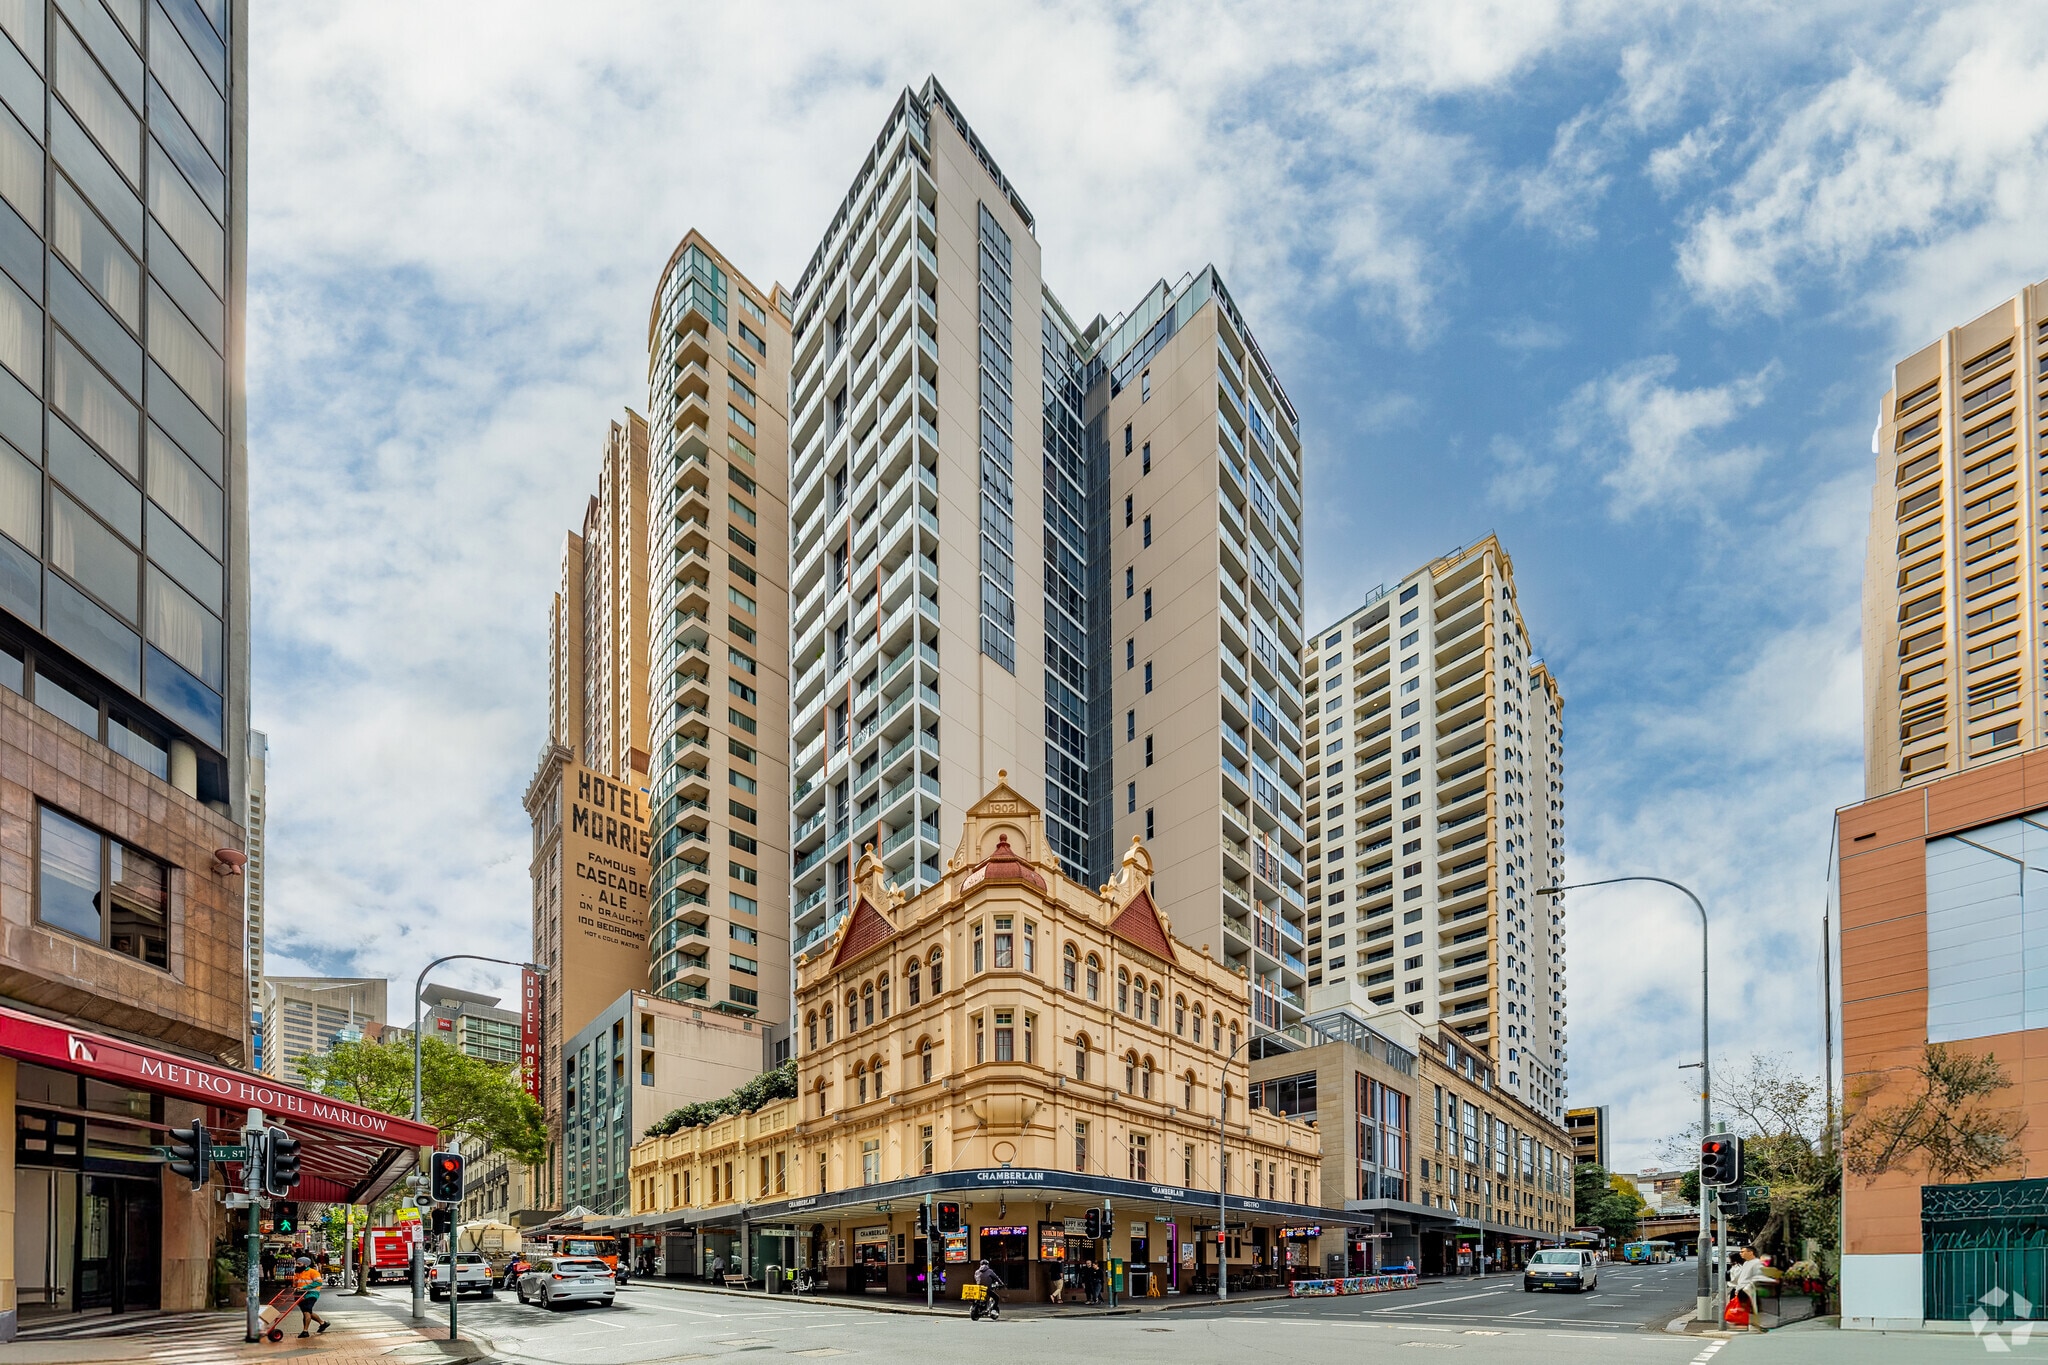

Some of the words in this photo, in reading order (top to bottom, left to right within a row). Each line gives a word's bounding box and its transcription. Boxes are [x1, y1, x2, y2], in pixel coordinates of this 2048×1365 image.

[578, 769, 645, 825] HOTEL
[990, 803, 1016, 813] 1902
[572, 802, 652, 860] MORRIS
[588, 851, 637, 876] FAMOUS
[576, 862, 648, 899] CASCADE
[598, 889, 627, 910] ALE
[579, 901, 593, 912] ON
[598, 906, 644, 927] DRAUGHT
[578, 915, 594, 927] 100
[596, 921, 646, 942] BEDROOMS
[584, 929, 597, 939] HOT
[602, 935, 619, 945] COLD
[620, 940, 640, 951] WATER
[526, 975, 534, 1035] HOTEL
[439, 1020, 450, 1029] ibis
[525, 1043, 535, 1095] MORR
[140, 1056, 233, 1095] METRO
[239, 1082, 307, 1115] HOTEL
[312, 1101, 389, 1133] MARLOW
[231, 1150, 246, 1158] ST
[976, 1171, 1044, 1181] CHAMBERLAIN
[1150, 1186, 1185, 1198] CHAMBERLAIN
[1243, 1200, 1260, 1209] BISTRO
